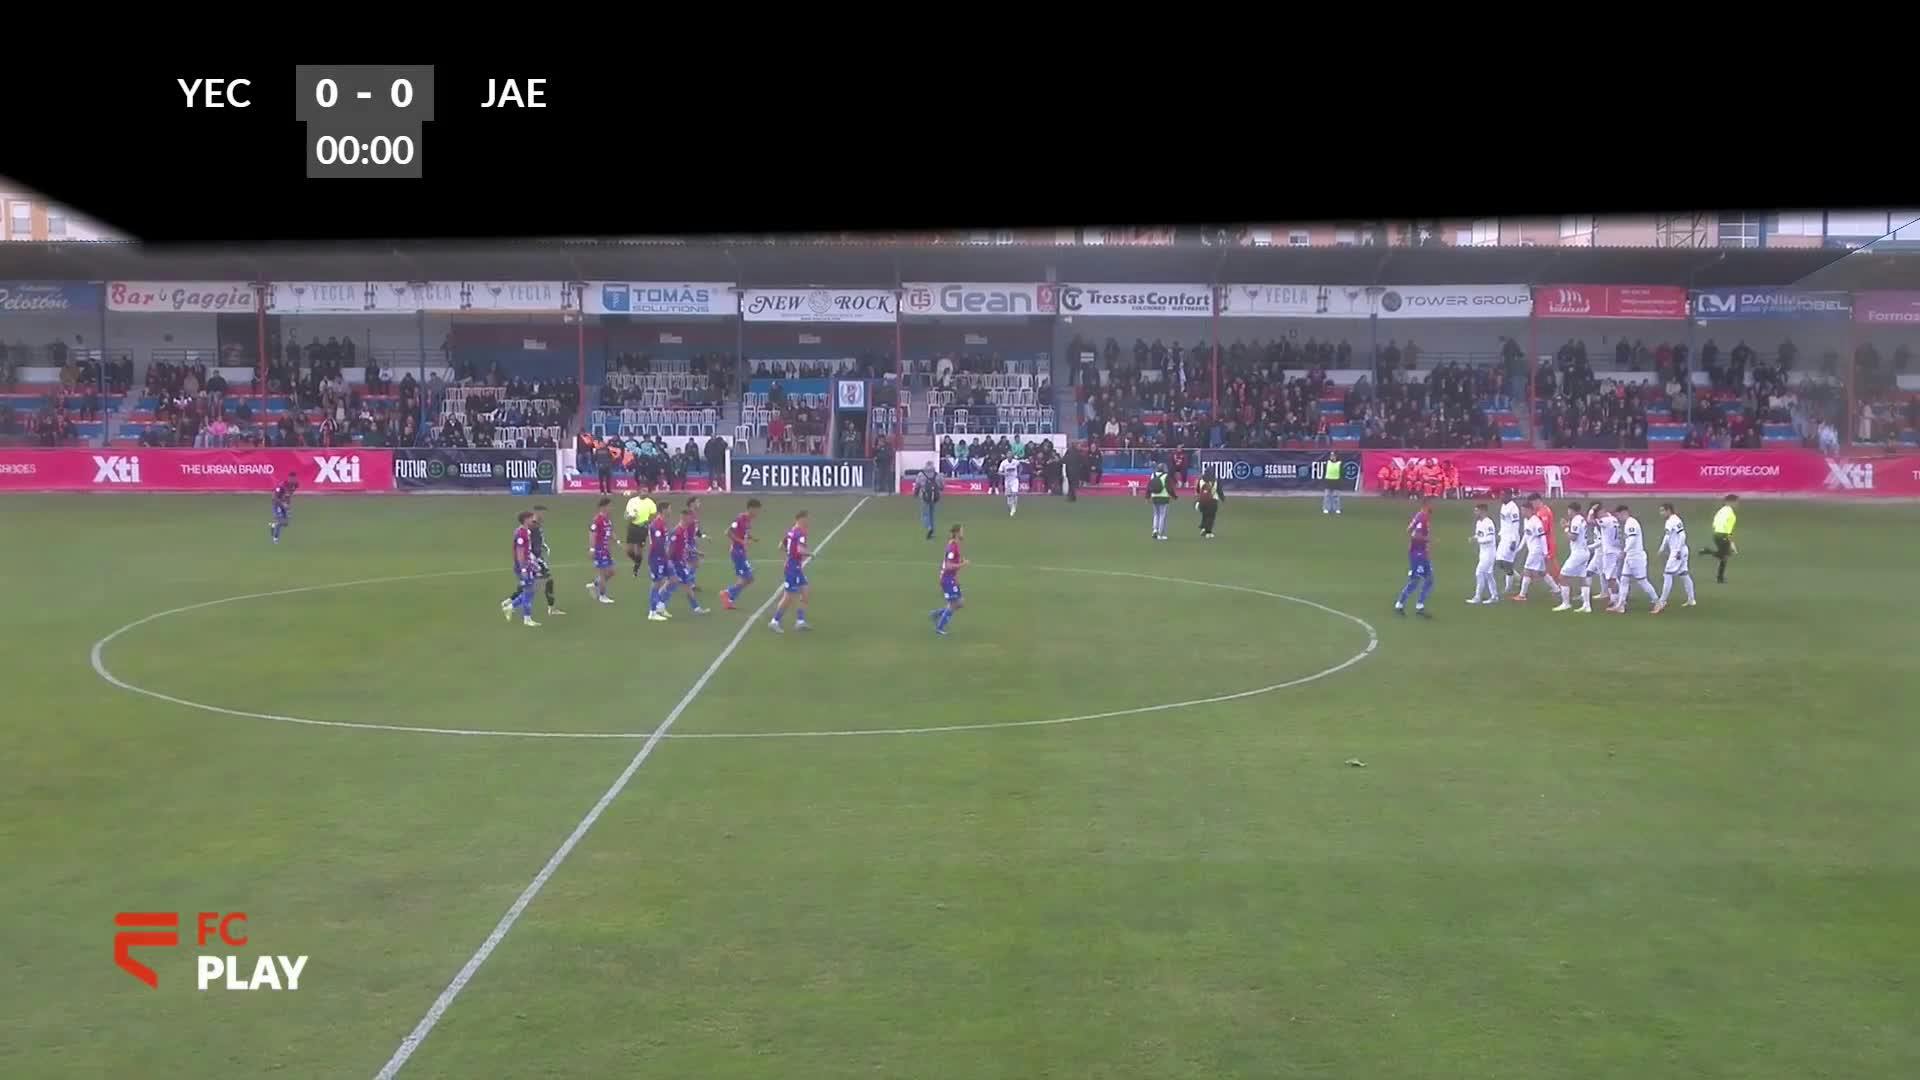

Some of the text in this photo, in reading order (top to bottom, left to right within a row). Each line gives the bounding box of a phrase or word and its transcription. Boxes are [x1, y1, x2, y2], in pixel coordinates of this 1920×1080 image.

[111, 283, 250, 310] Bar Gaggia
[748, 296, 805, 314] NEW
[834, 296, 894, 313] ROCK
[940, 284, 1032, 313] Gean
[1406, 295, 1529, 307] TOWER GROUP
[92, 455, 140, 483] Xti
[181, 464, 274, 475] THE URBAN BRAND
[313, 455, 361, 483] Xti
[762, 462, 863, 487] FEDERACIÓN
[1478, 465, 1499, 475] THE
[1499, 465, 1534, 475] URBAN
[1608, 458, 1655, 485] Xti
[1823, 458, 1873, 489] Xti
